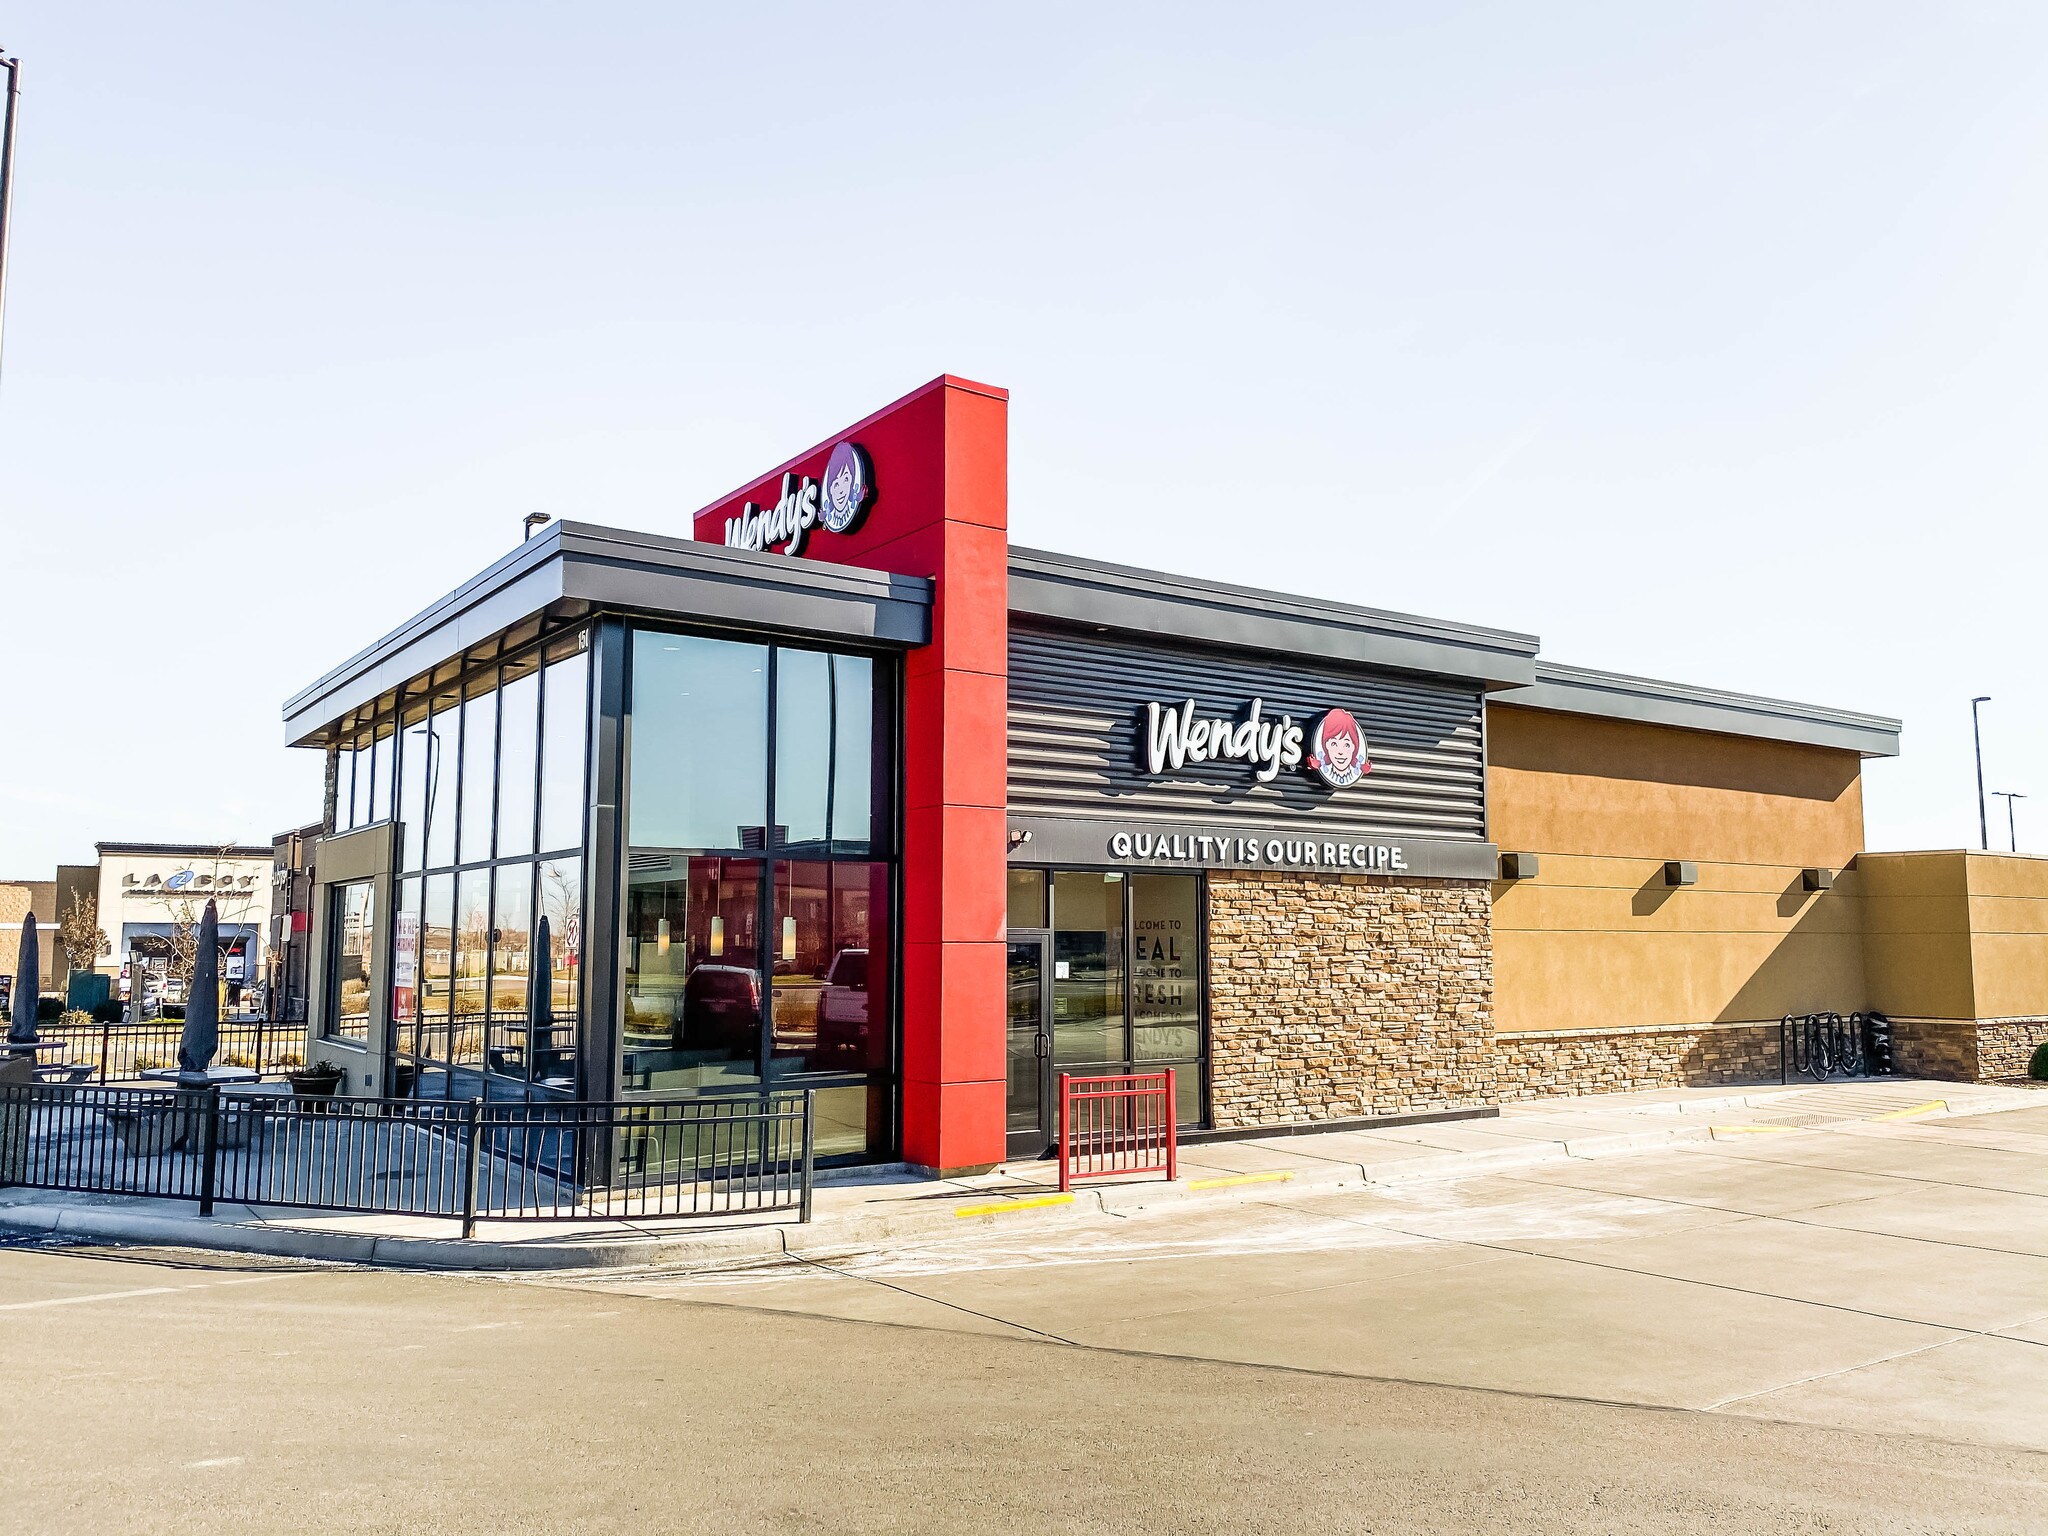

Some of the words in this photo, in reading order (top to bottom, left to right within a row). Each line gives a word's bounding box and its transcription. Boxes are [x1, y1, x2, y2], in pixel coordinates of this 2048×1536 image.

[725, 472, 818, 556] Wendy's
[1148, 697, 1304, 783] Wendy's
[1111, 831, 1231, 862] QUALITY
[1237, 837, 1260, 863] IS
[1266, 838, 1318, 865] OUR
[1323, 842, 1409, 870] RECIPE.
[1134, 920, 1166, 930] LCOME
[1169, 920, 1182, 930] TO
[1136, 936, 1181, 961] EAL
[1169, 968, 1182, 978] TO
[1134, 984, 1182, 1006] RESH
[1169, 1012, 1182, 1022] TO
[1135, 1028, 1184, 1047] ENDY'S
